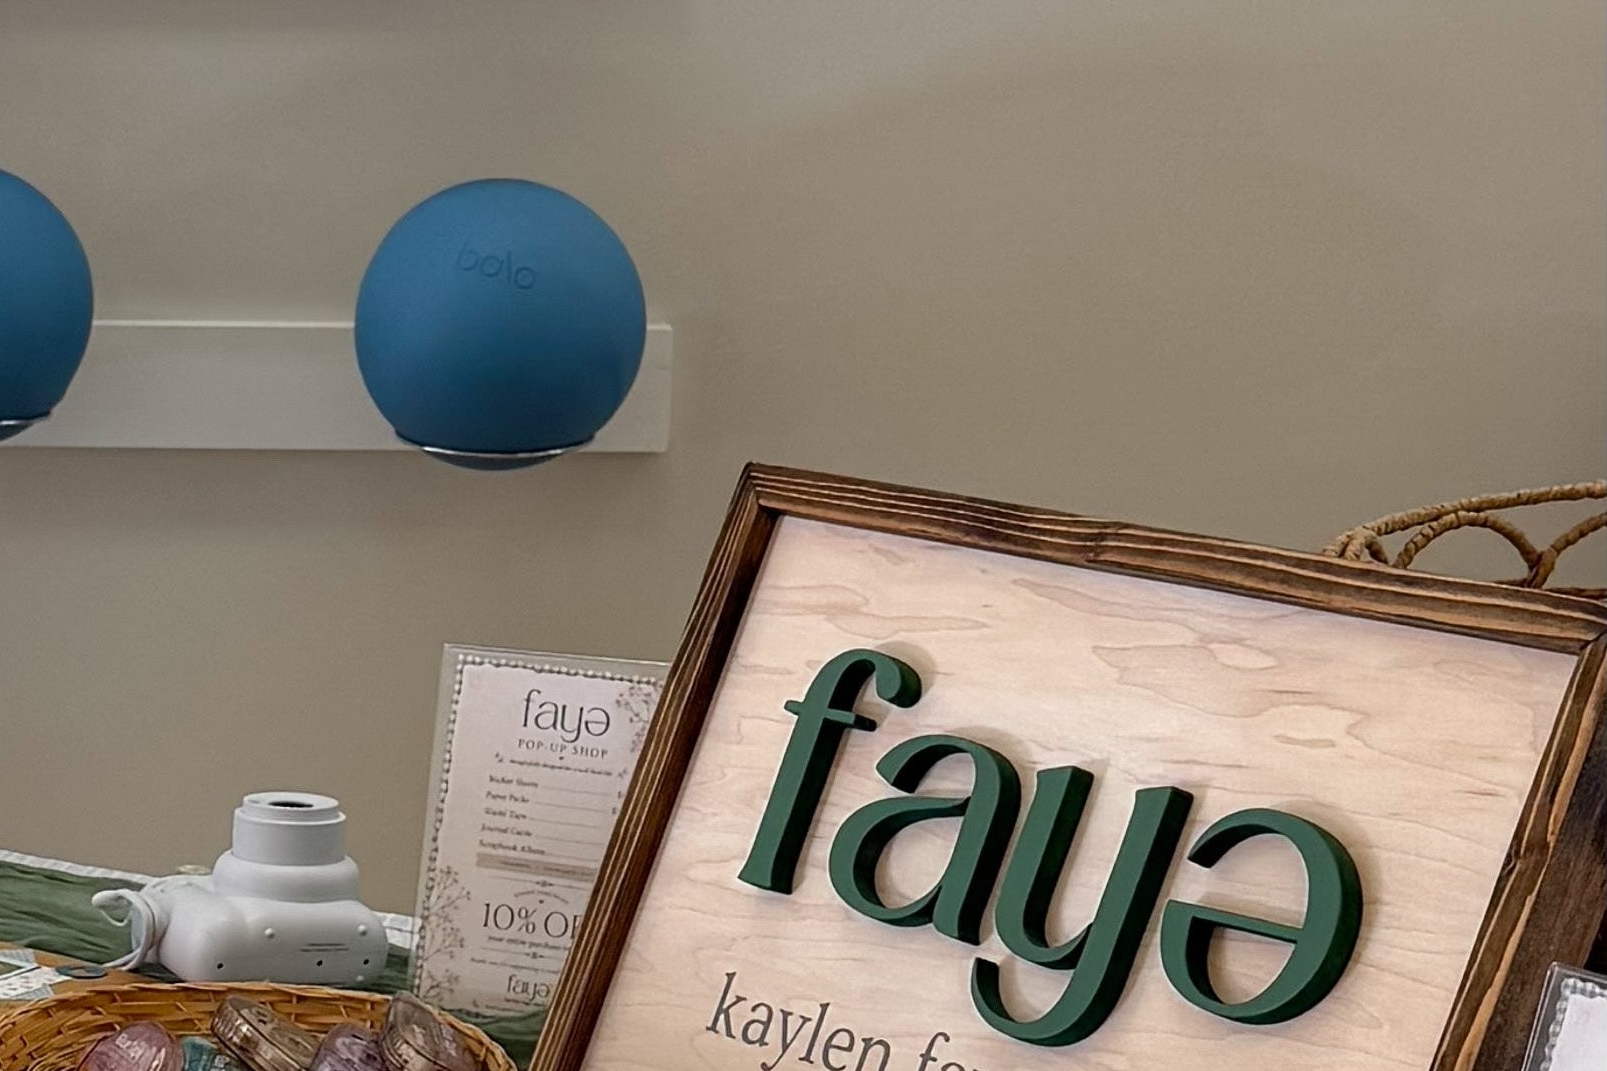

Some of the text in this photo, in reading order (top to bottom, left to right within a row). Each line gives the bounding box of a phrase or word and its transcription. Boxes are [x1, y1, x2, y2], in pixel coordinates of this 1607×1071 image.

[572, 745, 608, 759] SHOP
[483, 903, 582, 940] 10% OF
